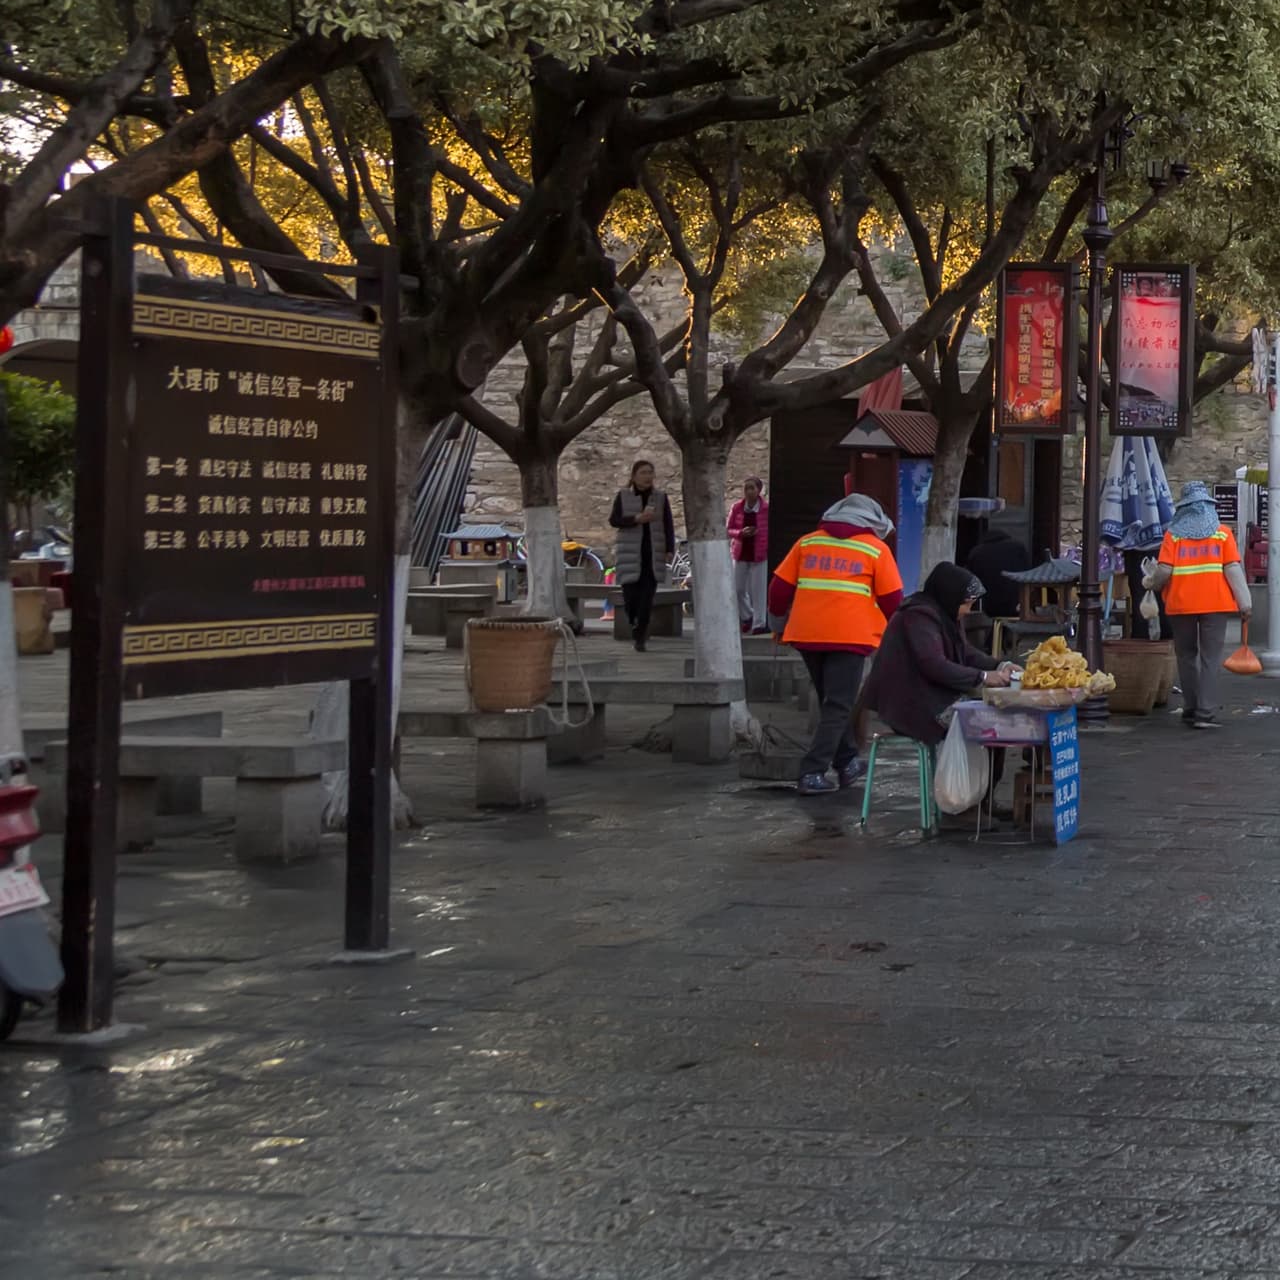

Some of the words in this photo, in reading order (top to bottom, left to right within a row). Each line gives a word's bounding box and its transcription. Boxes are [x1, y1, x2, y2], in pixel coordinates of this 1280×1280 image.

[208, 414, 319, 440] 诚信经营自律公约
[145, 456, 189, 478] 第一条
[198, 458, 254, 480] 遵纪守法
[261, 460, 313, 481] 诚信经营
[320, 462, 369, 483] 礼貌待客
[144, 494, 189, 516] 第二条
[197, 495, 253, 516] 货真价实
[260, 496, 312, 516] 信守承诺
[319, 497, 369, 516] 童叟无欺
[143, 529, 188, 551] 第三条
[197, 529, 251, 550] 公平竞争
[260, 529, 311, 549] 文明经营
[319, 528, 368, 548] 优质服务
